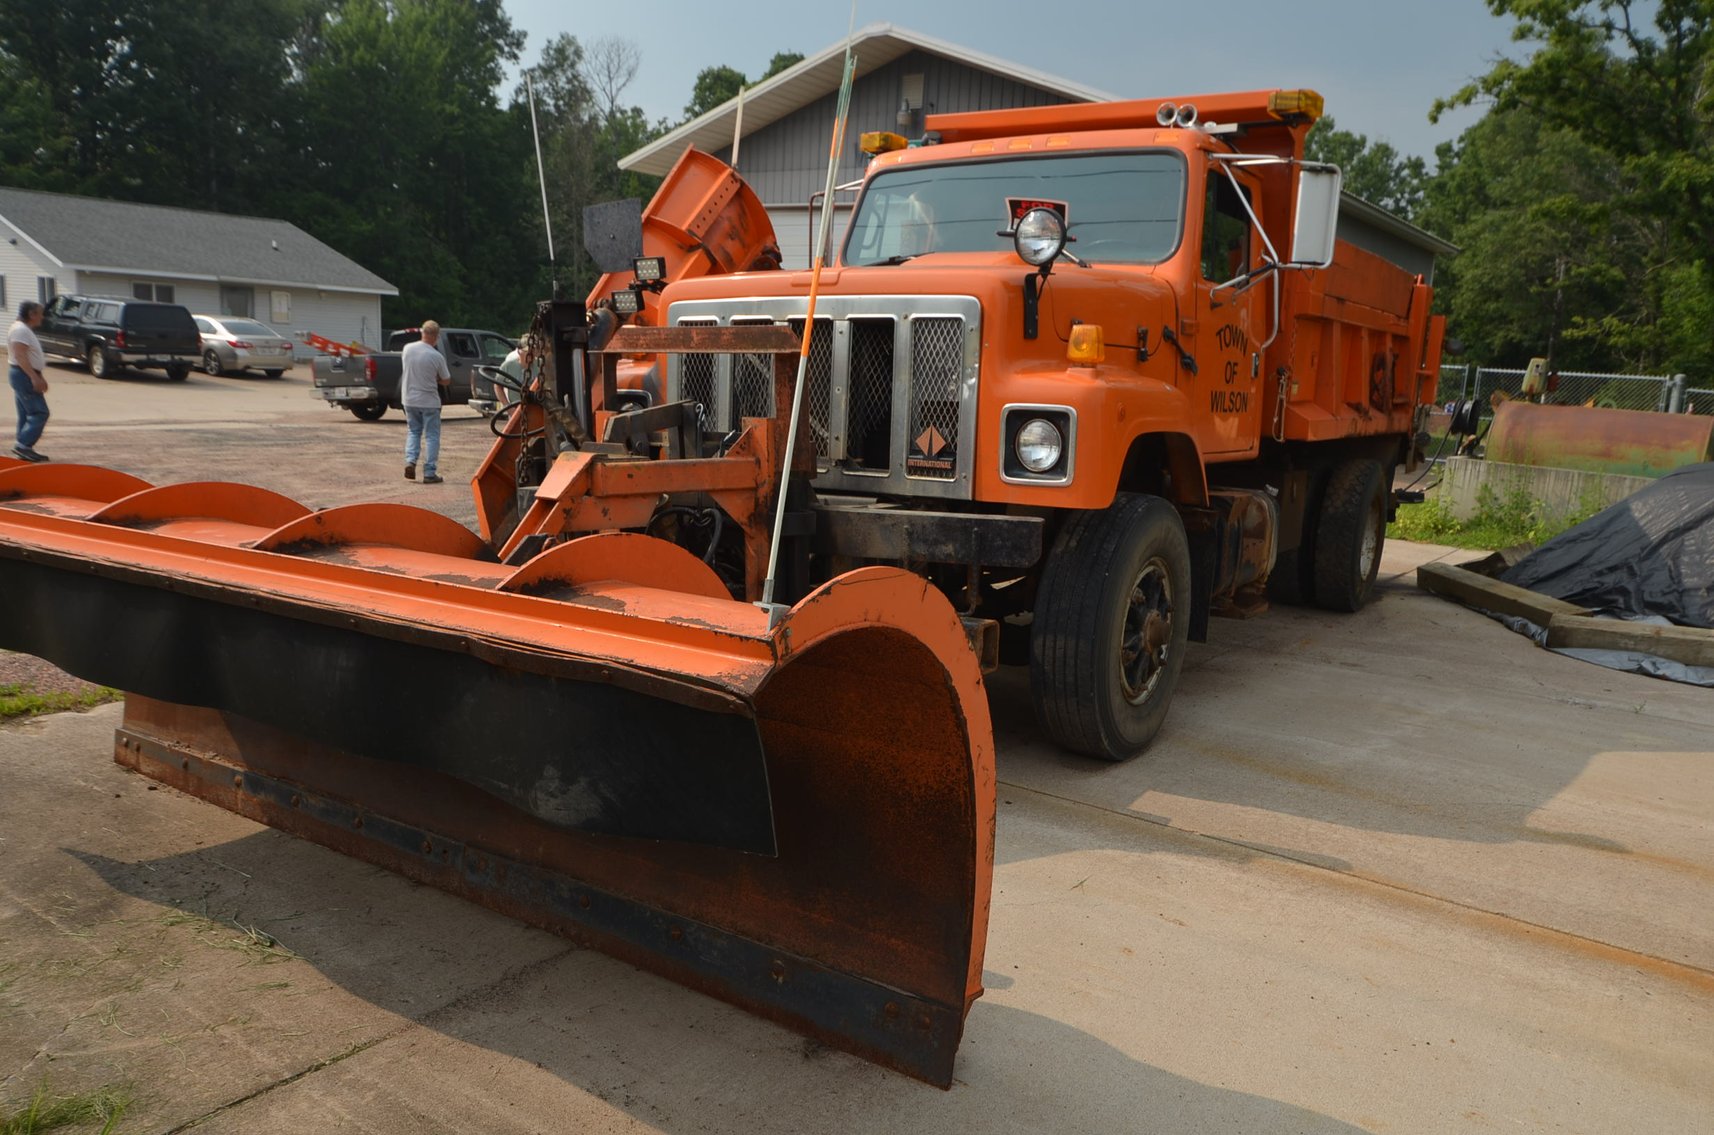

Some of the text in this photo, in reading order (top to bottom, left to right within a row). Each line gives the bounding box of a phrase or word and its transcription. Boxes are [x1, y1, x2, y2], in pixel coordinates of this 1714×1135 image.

[1216, 324, 1248, 357] TOWN
[1225, 361, 1238, 384] OF
[1210, 390, 1248, 413] WILSON
[907, 459, 952, 469] INTERNATIONAL
